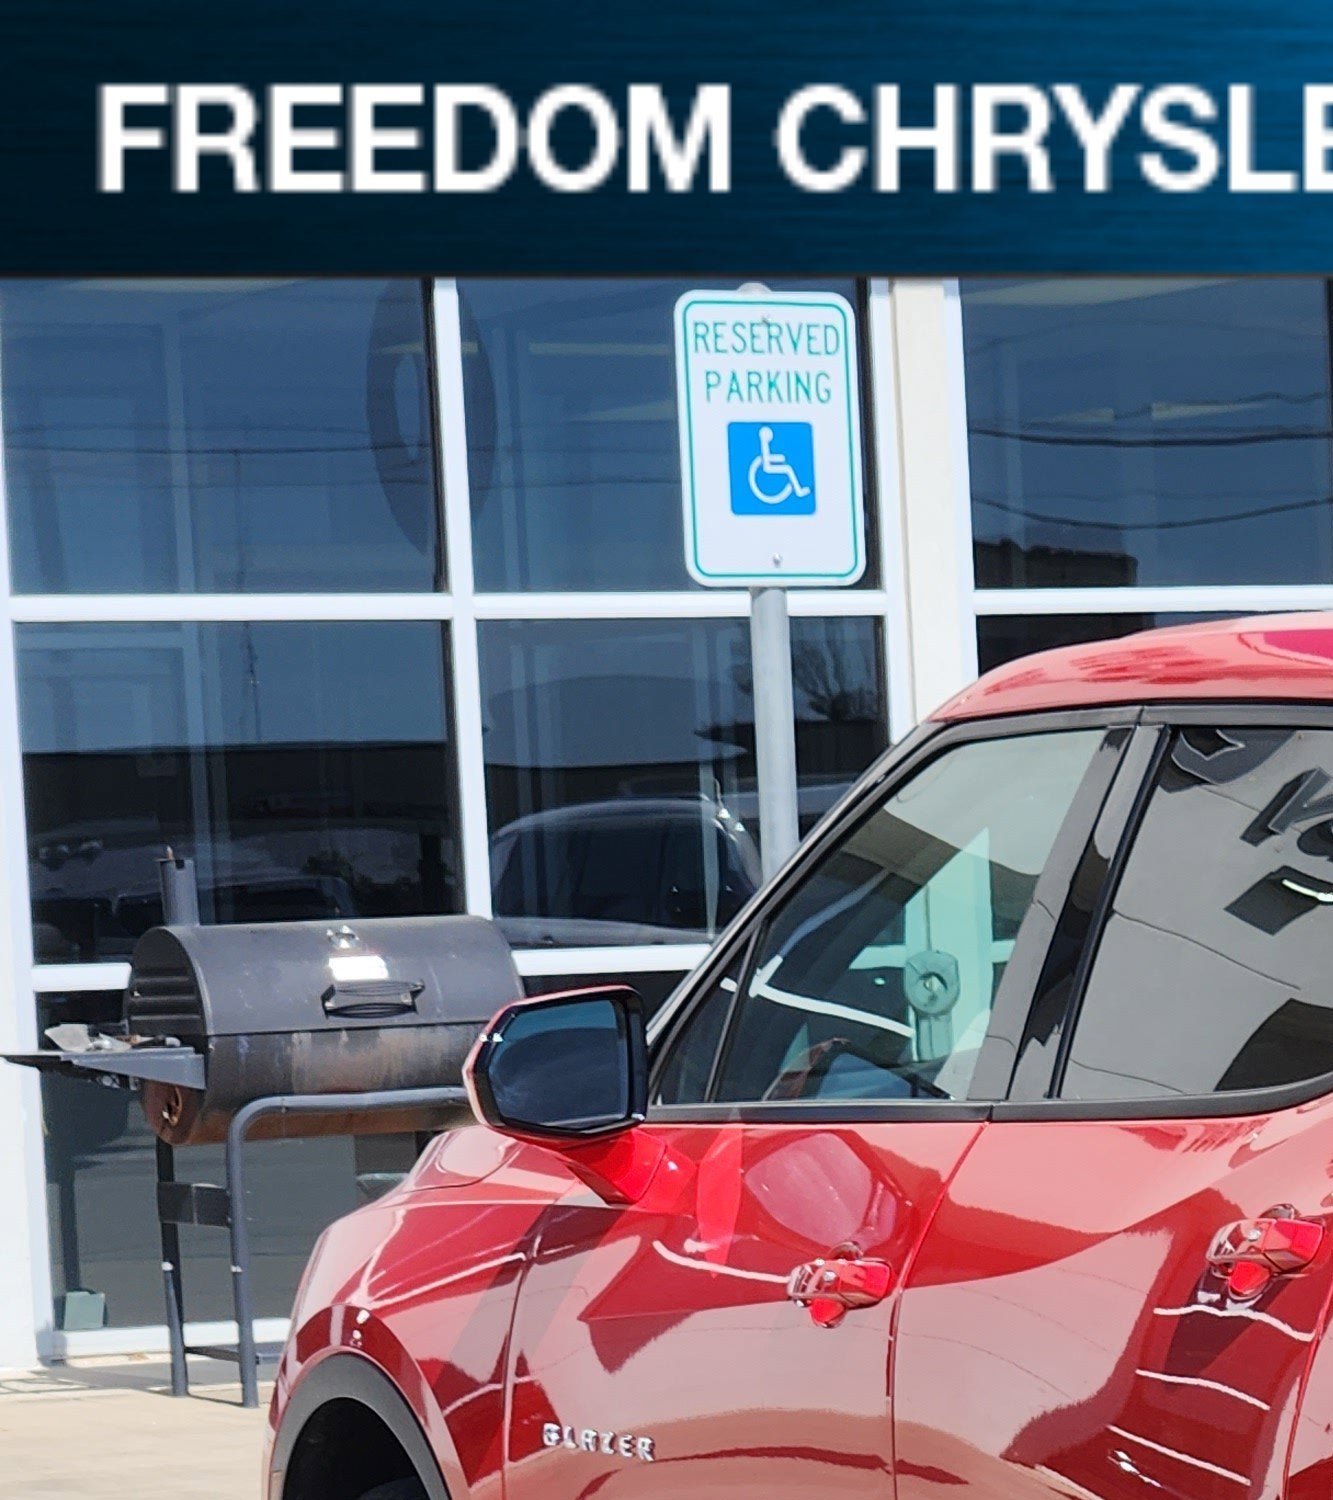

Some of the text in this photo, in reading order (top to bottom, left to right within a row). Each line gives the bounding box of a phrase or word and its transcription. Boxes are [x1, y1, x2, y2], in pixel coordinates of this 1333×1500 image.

[693, 321, 840, 356] RESERVED
[704, 370, 832, 404] PARKING
[541, 1422, 656, 1462] BLAZER
